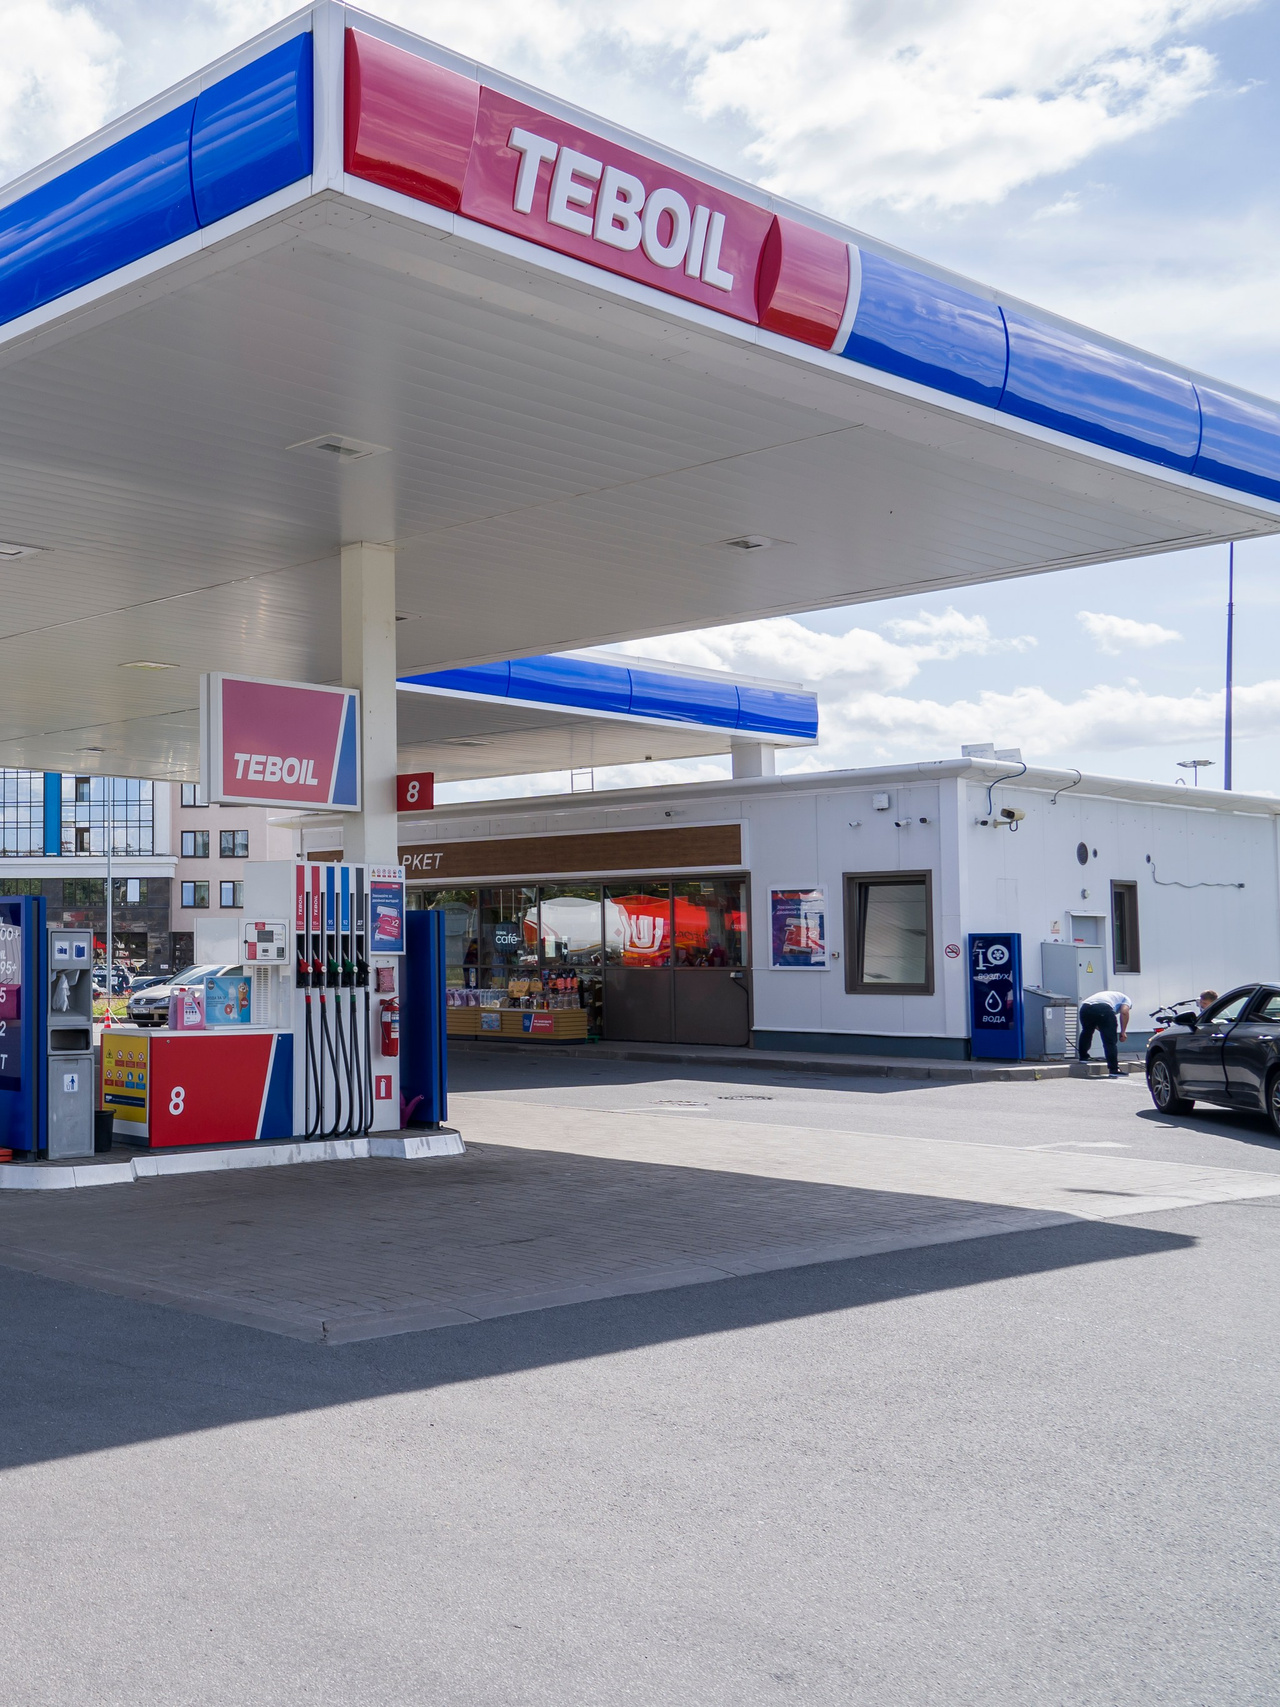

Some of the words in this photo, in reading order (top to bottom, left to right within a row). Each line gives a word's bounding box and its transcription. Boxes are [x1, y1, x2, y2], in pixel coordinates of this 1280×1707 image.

[507, 126, 734, 292] TEBOIL
[234, 752, 318, 786] TEBOIL
[407, 781, 420, 802] 8
[401, 853, 443, 870] РКЕТ
[0, 961, 17, 975] 95+
[982, 1015, 1006, 1023] ВОДА
[168, 1086, 186, 1116] 8
